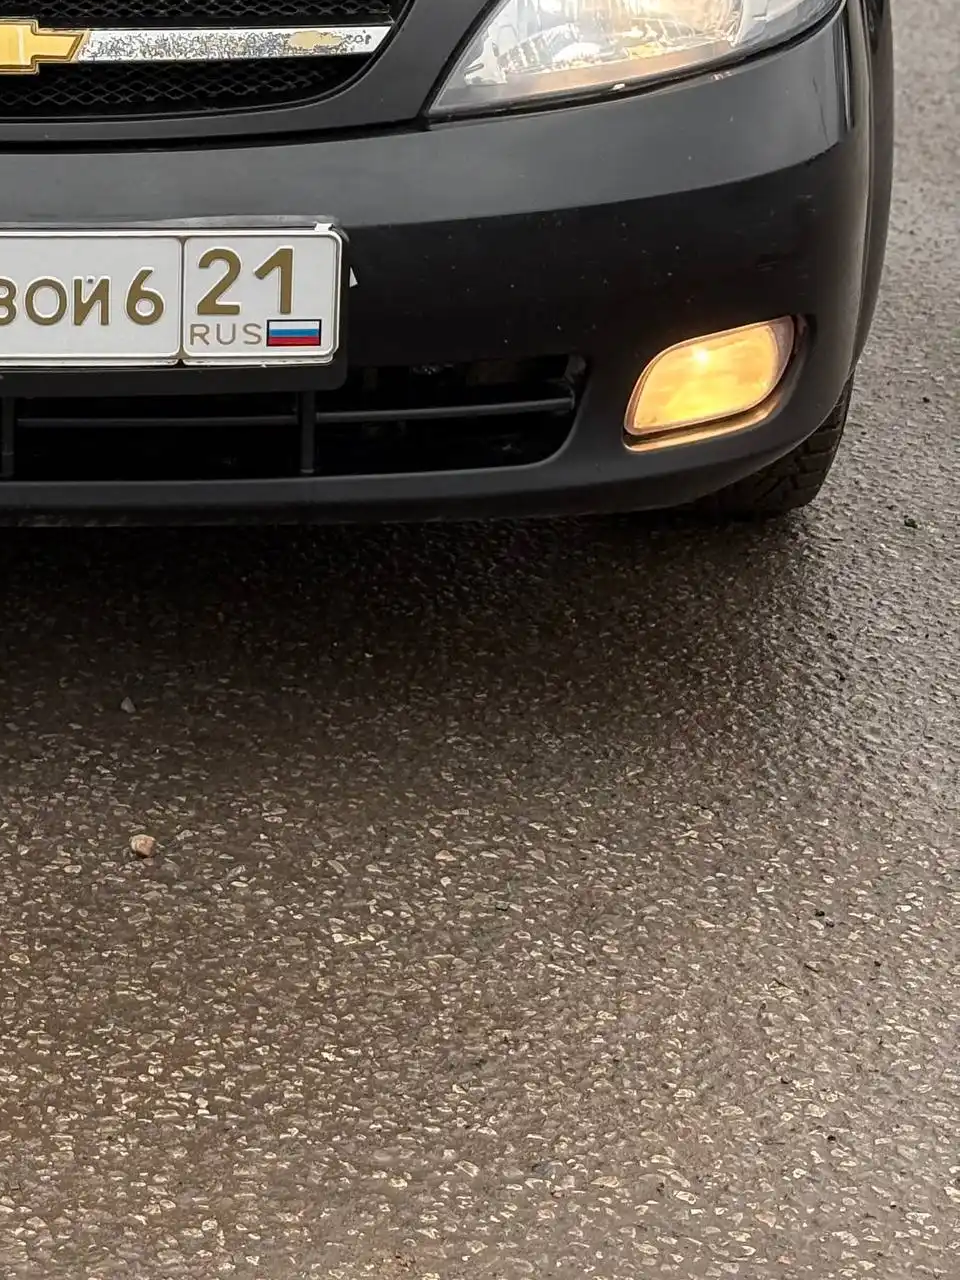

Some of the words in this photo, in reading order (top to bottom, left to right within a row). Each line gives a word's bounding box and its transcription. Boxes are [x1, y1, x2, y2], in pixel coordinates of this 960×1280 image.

[125, 267, 166, 326] 6
[196, 246, 296, 317] 21
[190, 322, 263, 345] RUS
